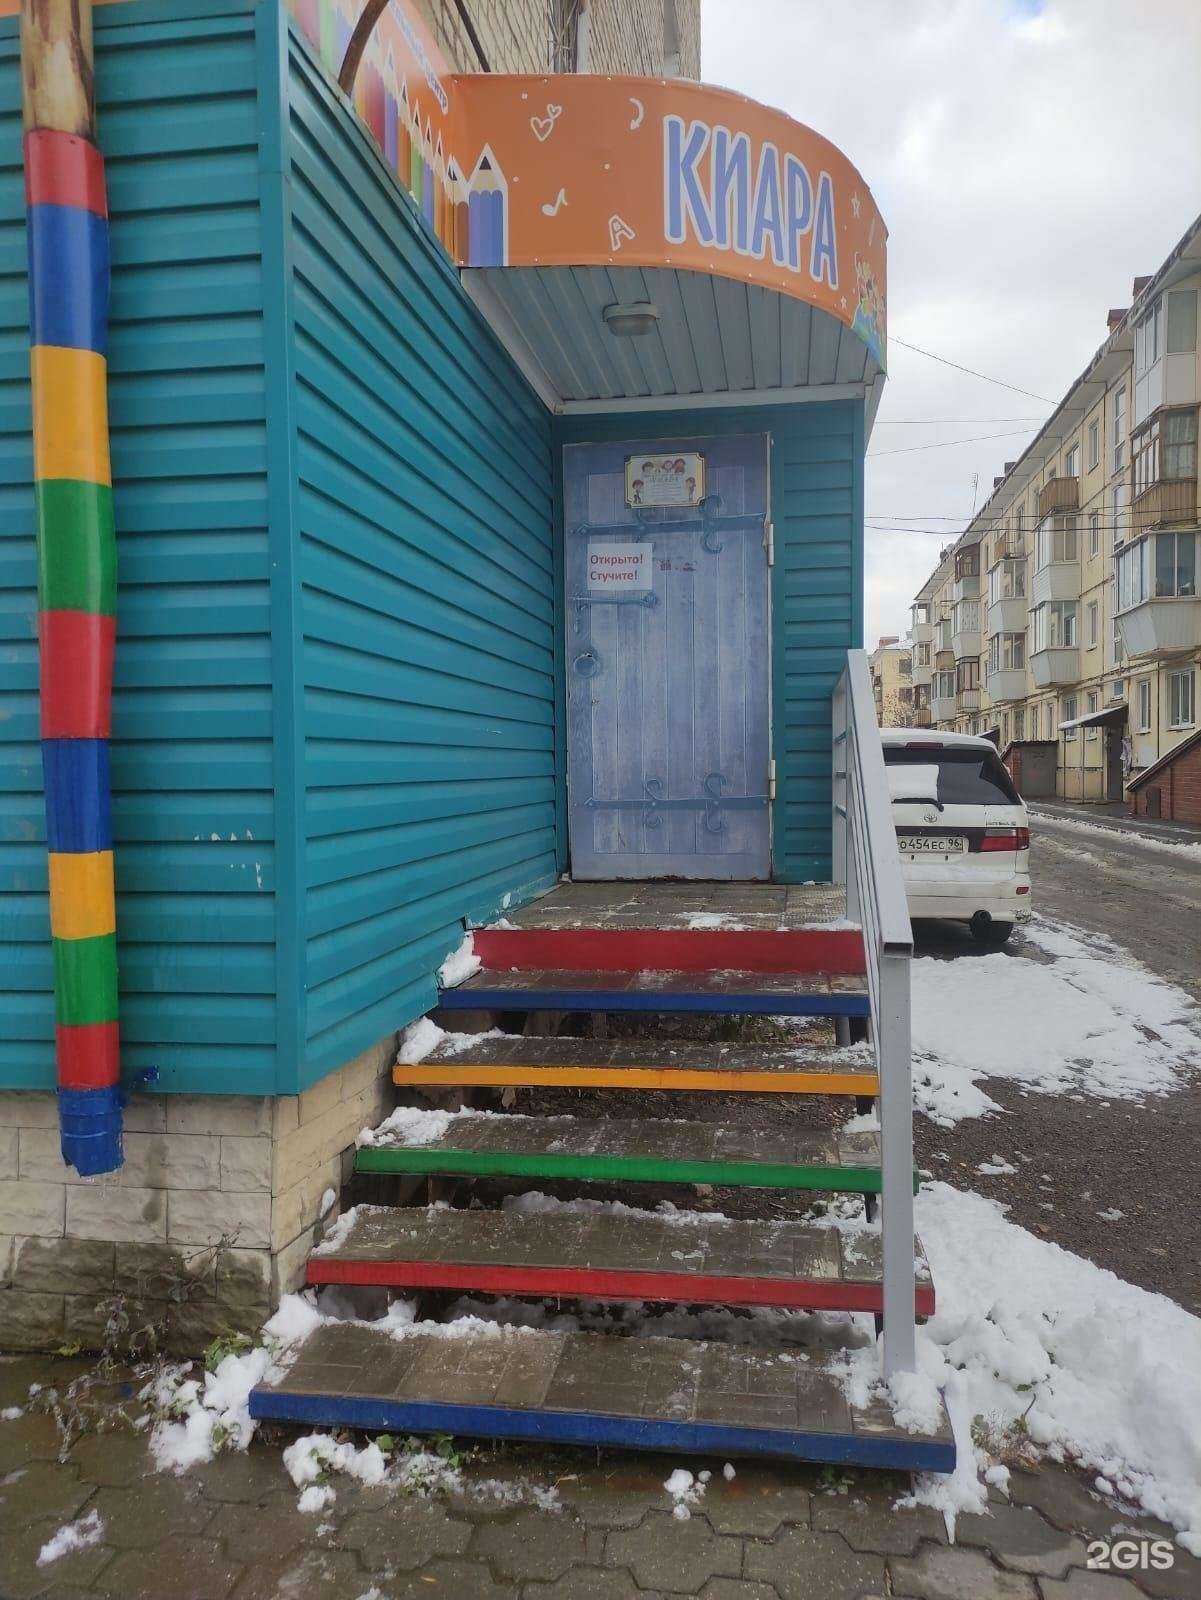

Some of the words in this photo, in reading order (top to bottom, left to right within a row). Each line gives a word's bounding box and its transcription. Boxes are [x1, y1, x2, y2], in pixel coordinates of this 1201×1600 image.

[664, 115, 838, 291] КИАРА
[590, 554, 643, 565] Открыто!
[590, 570, 638, 583] Стучите!
